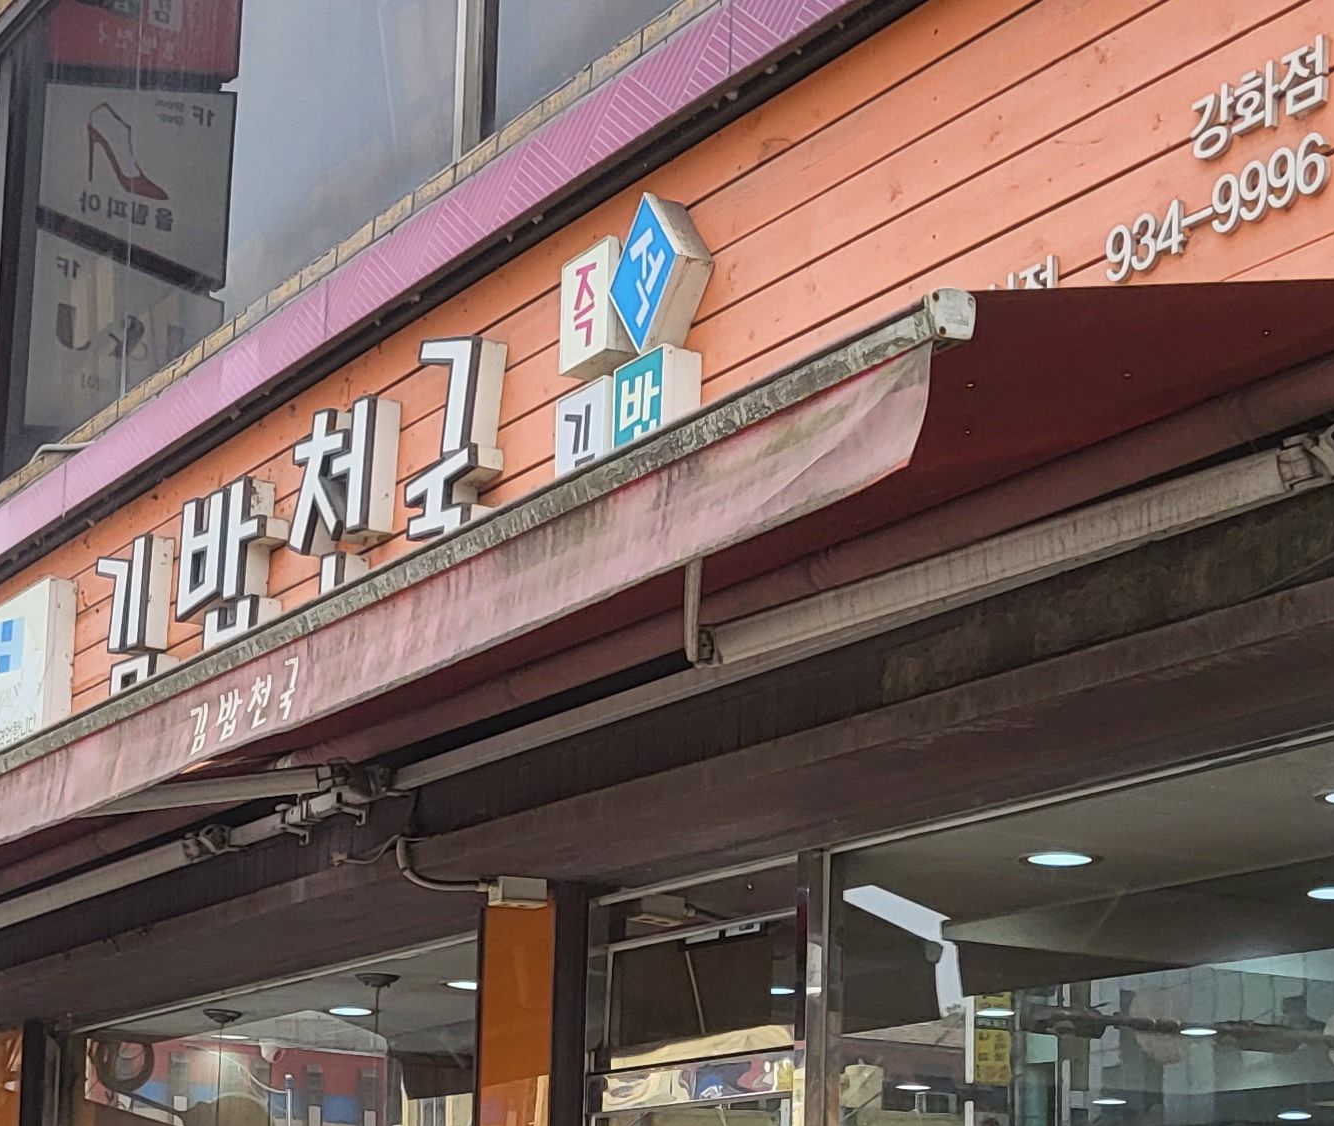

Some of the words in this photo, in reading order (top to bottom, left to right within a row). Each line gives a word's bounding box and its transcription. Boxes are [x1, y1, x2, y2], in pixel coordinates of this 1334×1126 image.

[1190, 34, 1330, 160] 강화점
[1105, 131, 1331, 283] 934-9996
[95, 335, 482, 697] 김밥천국
[189, 657, 300, 757] 김밥천국
